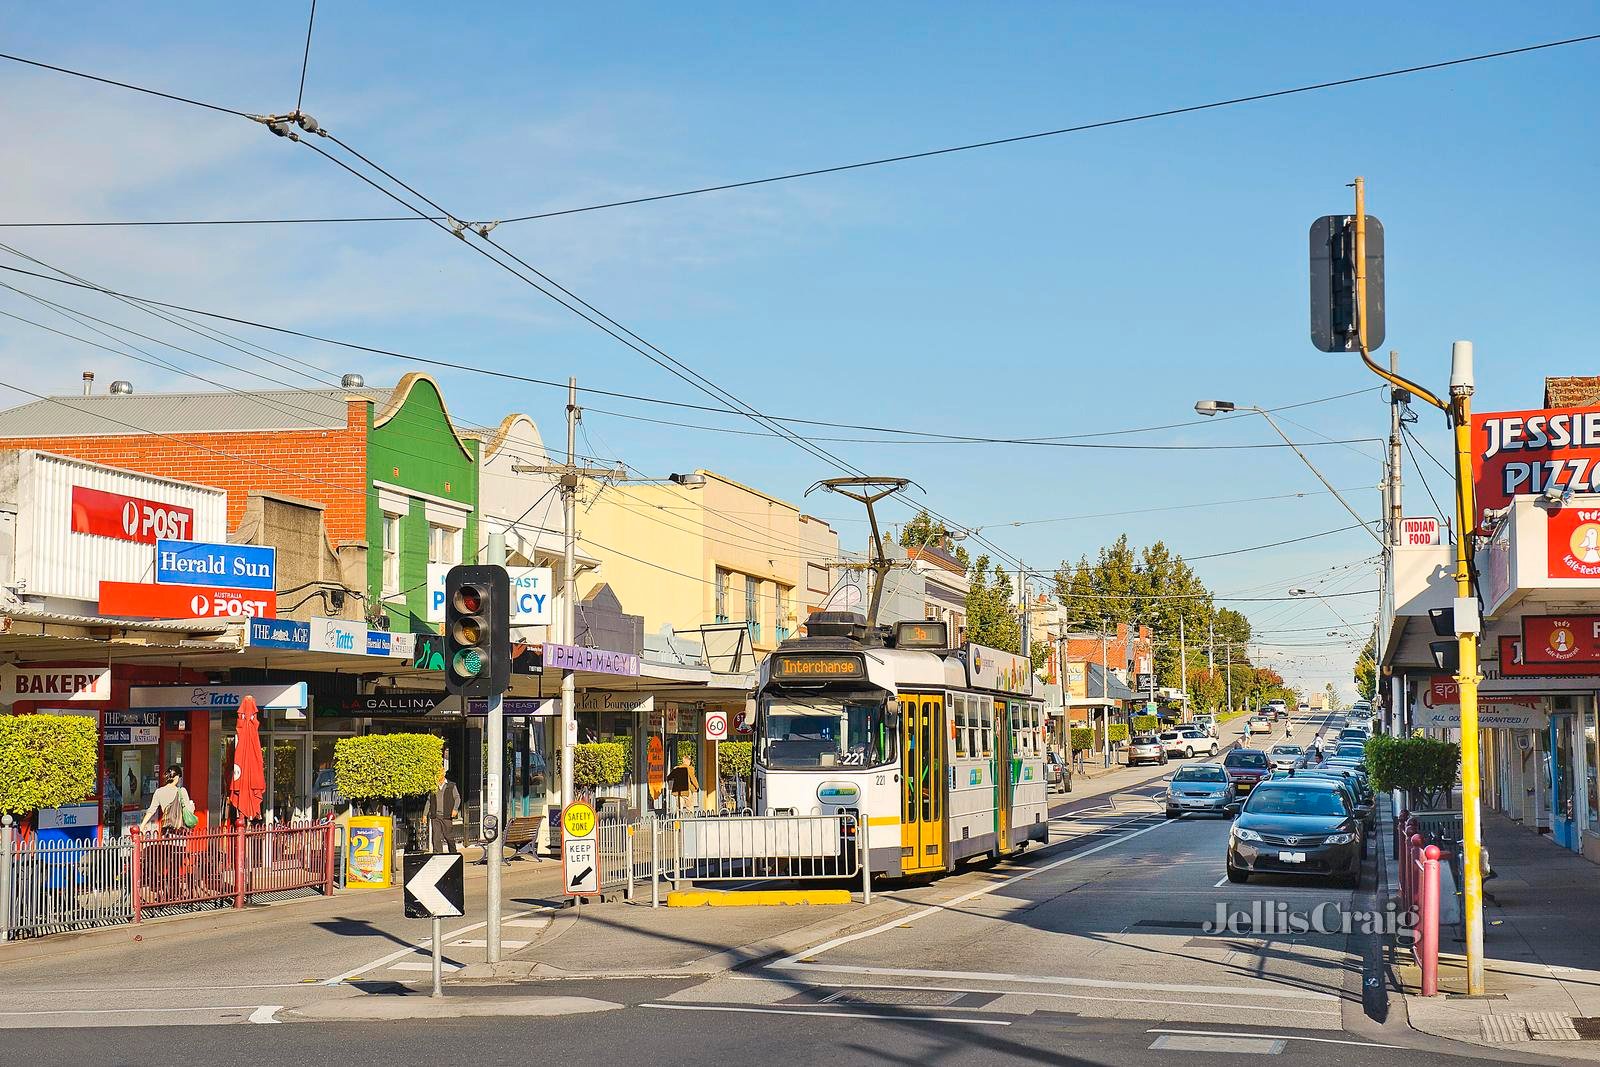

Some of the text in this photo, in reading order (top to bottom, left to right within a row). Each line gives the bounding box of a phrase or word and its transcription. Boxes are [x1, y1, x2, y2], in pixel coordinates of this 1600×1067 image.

[142, 508, 190, 540] POST
[1404, 520, 1435, 533] INDIAN
[1408, 533, 1431, 545] FOOD
[160, 551, 271, 578] Herald Sun
[213, 600, 268, 618] POST
[252, 623, 309, 643] THE AGE
[335, 629, 354, 650] Tatts
[556, 647, 629, 672] PHARMACY
[783, 659, 855, 674] Interchange
[15, 674, 101, 694] BAKERY
[208, 692, 239, 705] Tatts
[342, 698, 435, 709] LA GALLINA
[580, 693, 599, 710] Petit
[603, 692, 646, 711] Bourgeois
[1478, 705, 1500, 714] ELI.
[104, 712, 158, 725] THE AGE
[709, 720, 724, 731] 60
[843, 752, 865, 766] 221
[875, 775, 886, 786] 221
[63, 814, 77, 825] Tatts
[567, 812, 591, 821] SAFETY
[571, 822, 588, 832] ZONE
[351, 834, 383, 858] 21
[569, 845, 591, 853] KEEP
[570, 854, 591, 863] LEFT
